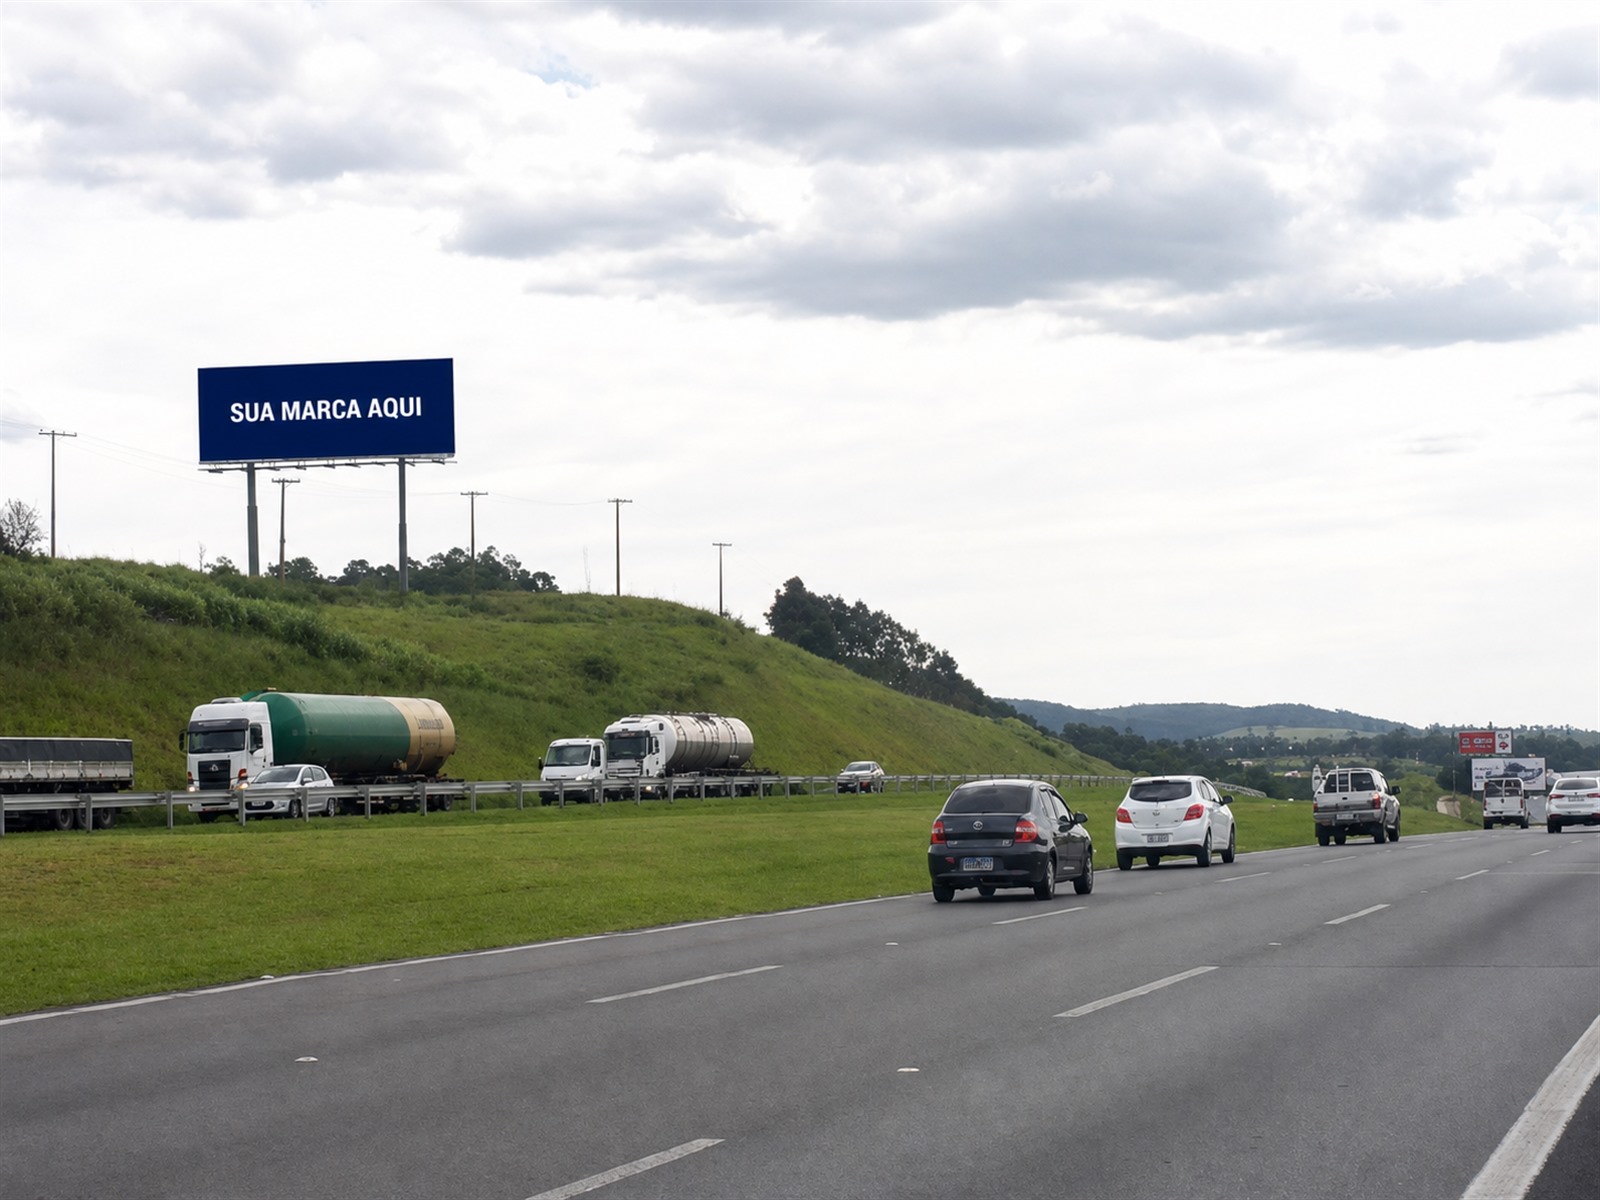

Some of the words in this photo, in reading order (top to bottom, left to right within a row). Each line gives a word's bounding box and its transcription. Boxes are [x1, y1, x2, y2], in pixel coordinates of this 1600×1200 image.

[230, 402, 275, 423] SUA
[281, 398, 362, 421] MARCA
[367, 396, 422, 420] AQUI
